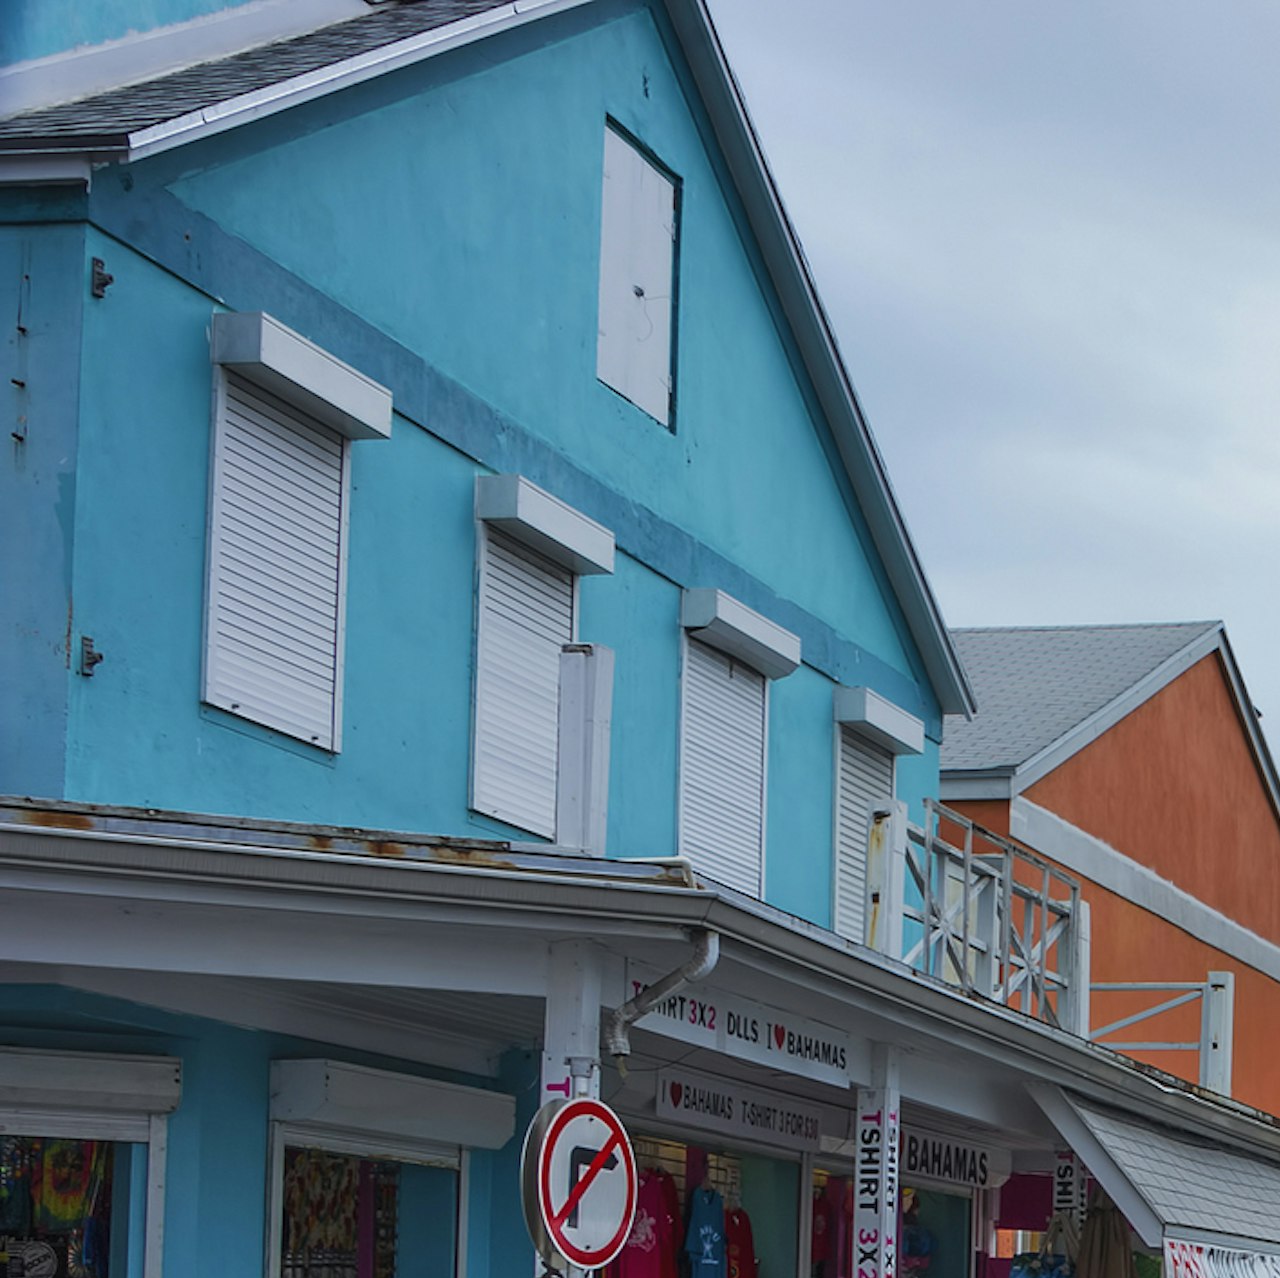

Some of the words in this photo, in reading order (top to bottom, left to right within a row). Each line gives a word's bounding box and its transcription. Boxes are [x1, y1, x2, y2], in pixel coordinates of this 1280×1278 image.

[726, 1011, 760, 1043] DLLS
[787, 1034, 847, 1070] BAHAMAS
[683, 1085, 734, 1121] BAHAMAS
[741, 1101, 777, 1132] T-SHIRT
[859, 1109, 882, 1215] TSHIRT
[886, 1110, 898, 1212] TSHIRT
[907, 1138, 989, 1186] BAHAMAS
[1056, 1151, 1075, 1219] TSHI
